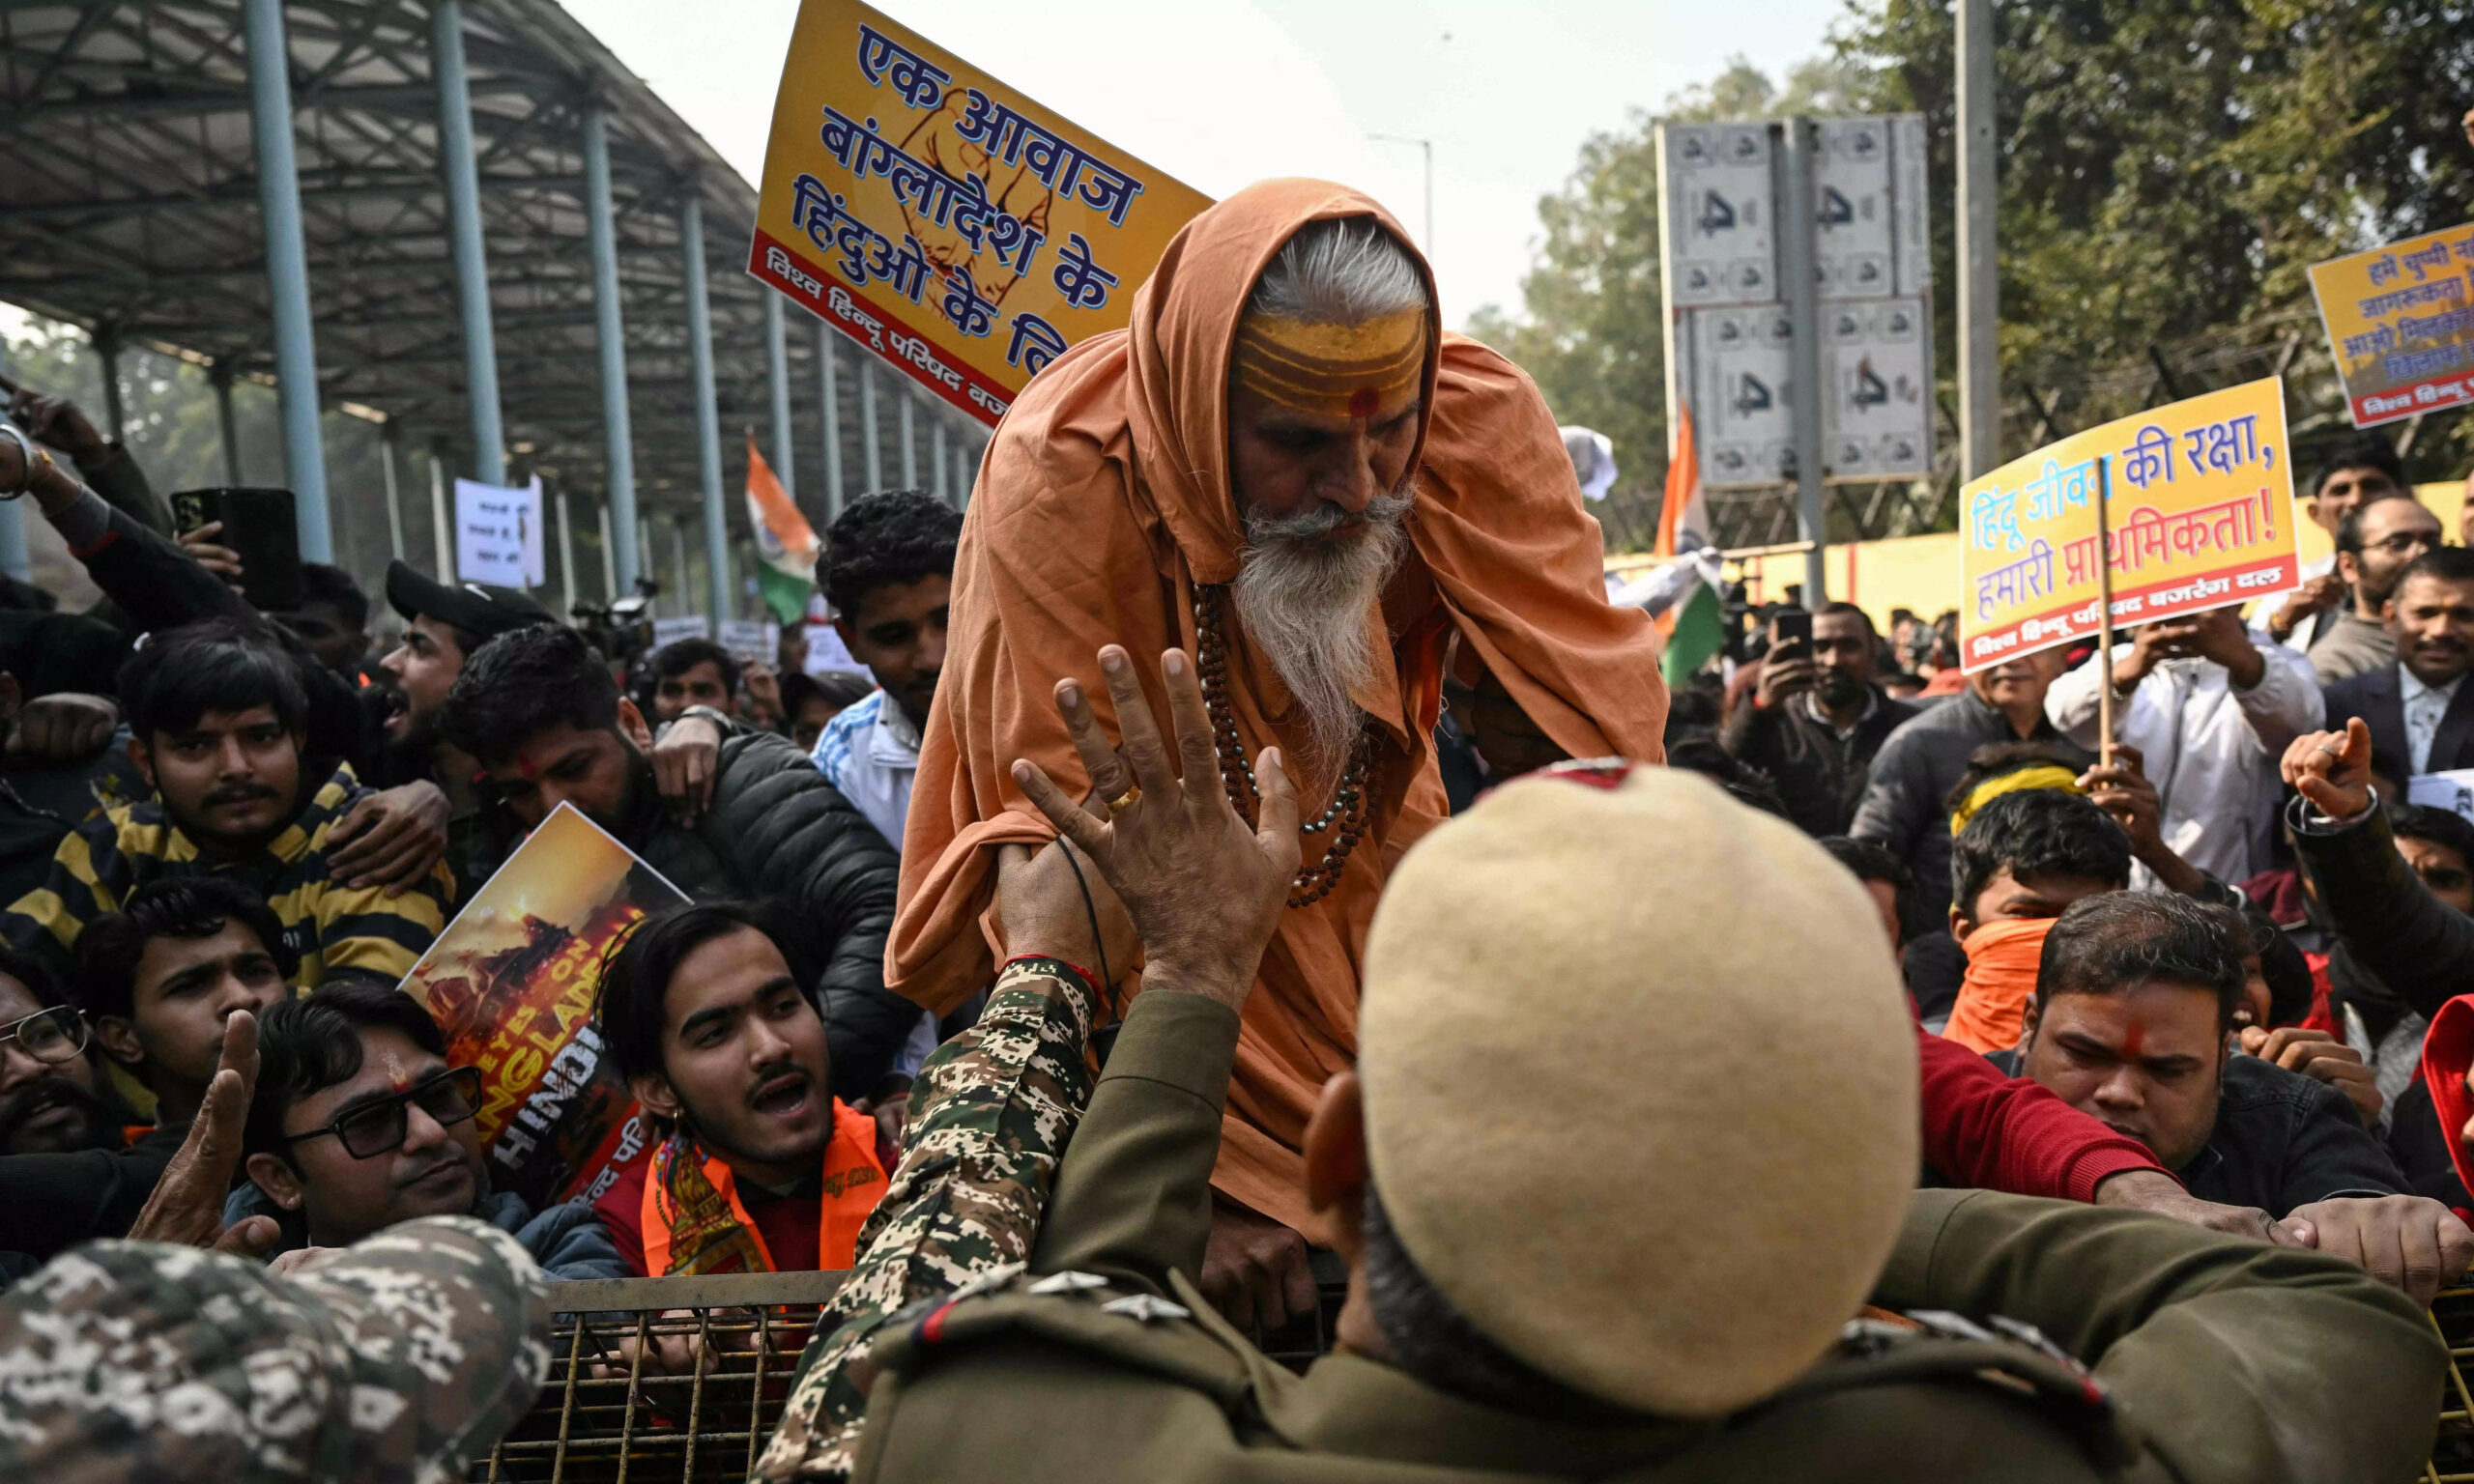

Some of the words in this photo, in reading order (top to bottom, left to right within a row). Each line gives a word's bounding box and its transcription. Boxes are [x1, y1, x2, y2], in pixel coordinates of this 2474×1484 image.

[857, 22, 951, 110] एक
[954, 88, 1144, 227] आवाज
[820, 105, 1045, 276] बांग्लादेश
[1053, 233, 1119, 309] के
[766, 246, 823, 301] विश्व
[828, 285, 886, 353] हिन्दू
[889, 334, 965, 391] परिषद
[941, 263, 999, 338] के
[1971, 487, 2025, 551] हिंदू
[2123, 425, 2174, 489] की
[2184, 414, 2274, 474] रक्षा,
[1977, 538, 2054, 620] हमारी
[477, 1004, 537, 1074] EYES
[551, 937, 592, 983] ON
